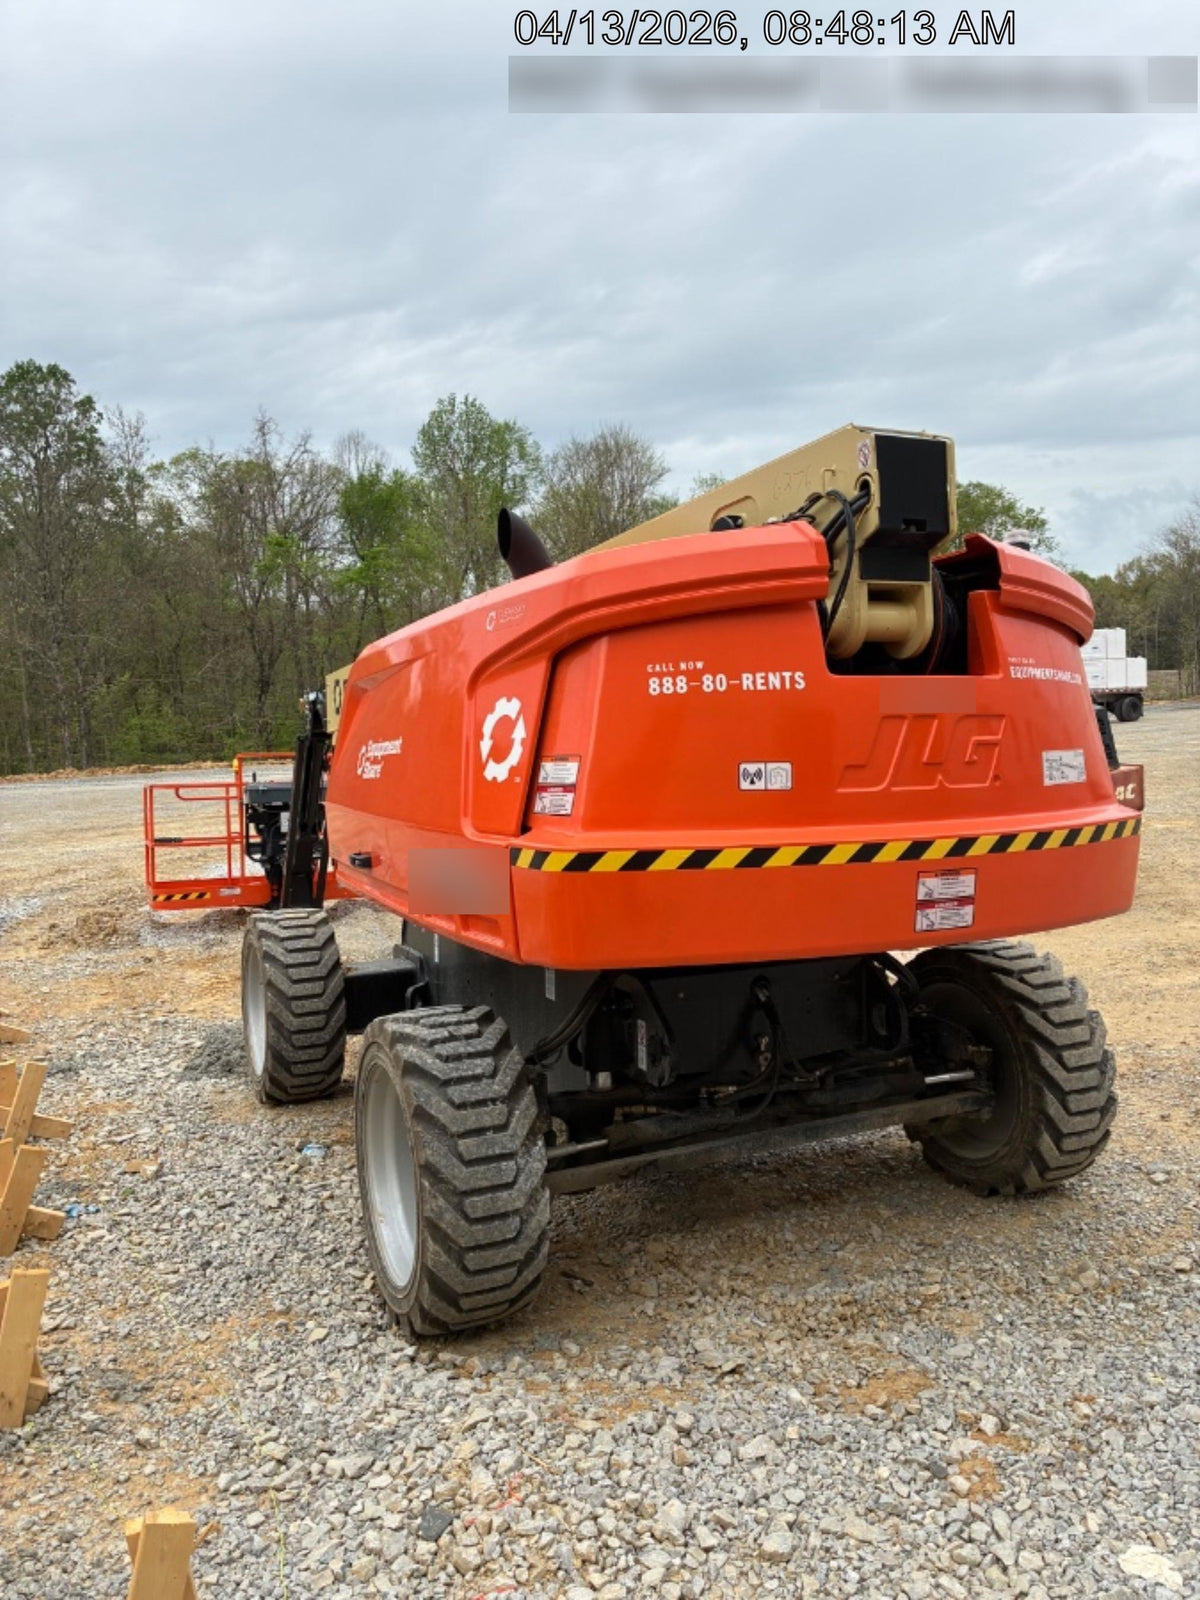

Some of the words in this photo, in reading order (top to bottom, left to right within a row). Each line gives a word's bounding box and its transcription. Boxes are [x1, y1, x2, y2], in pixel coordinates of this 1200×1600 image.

[646, 664, 675, 674] CALL
[679, 661, 705, 671] NOW
[648, 671, 807, 696] 888-80-RENTS
[836, 713, 1006, 792] JLG
